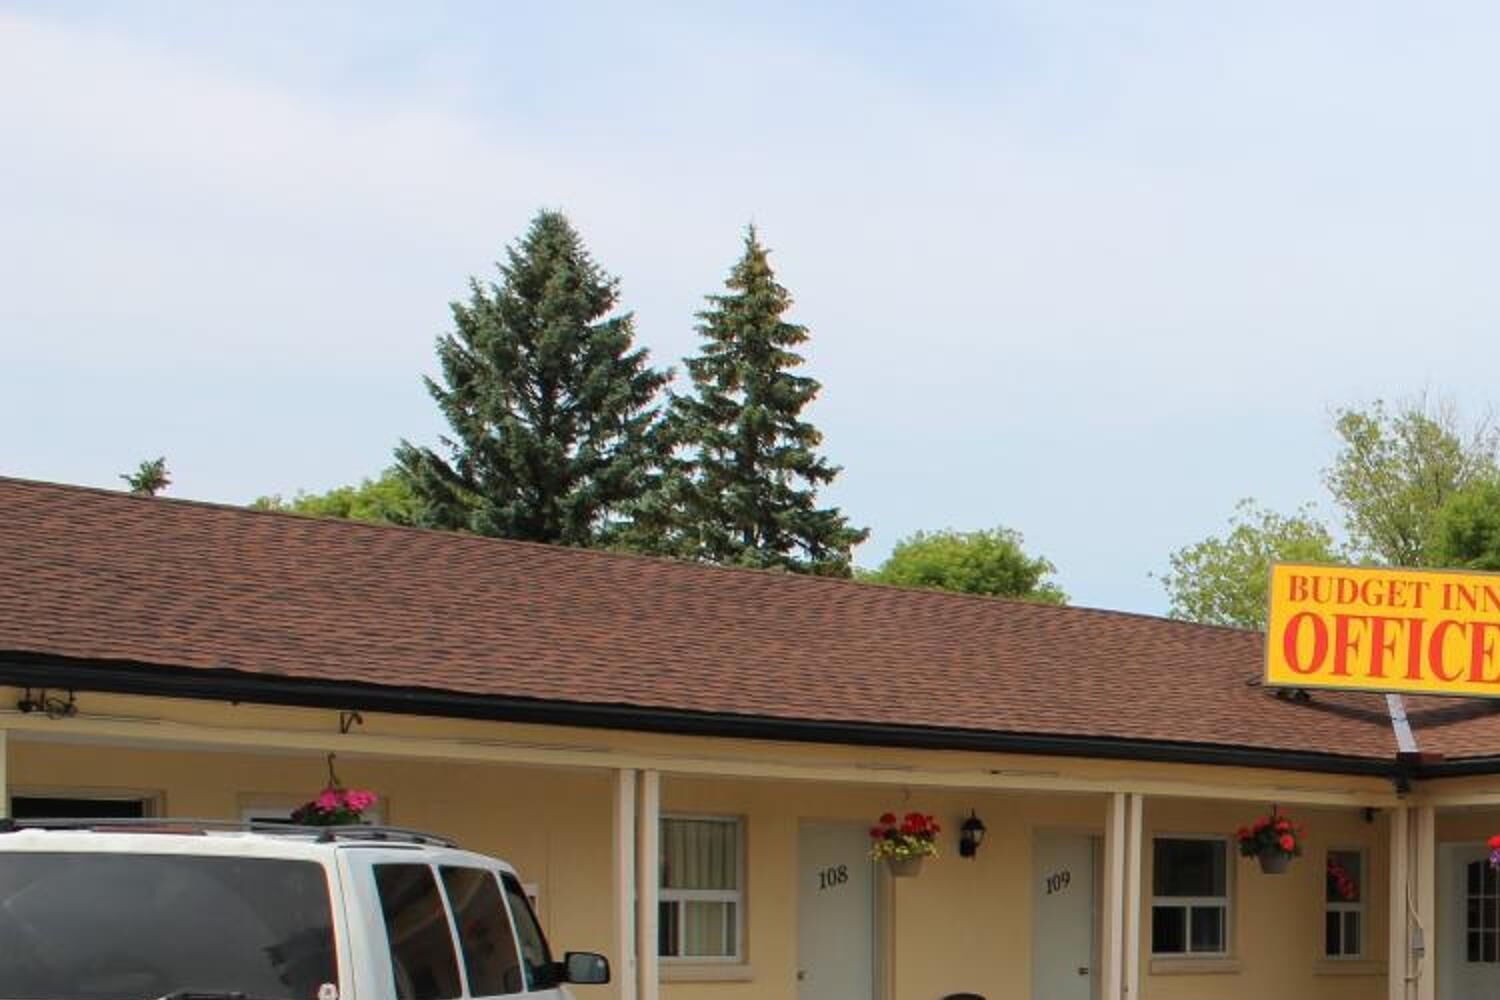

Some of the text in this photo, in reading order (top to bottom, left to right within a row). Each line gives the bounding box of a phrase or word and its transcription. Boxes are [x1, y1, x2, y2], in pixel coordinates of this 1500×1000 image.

[1288, 574, 1430, 609] BUDGET
[817, 865, 849, 891] 108
[1045, 870, 1071, 895] 109
